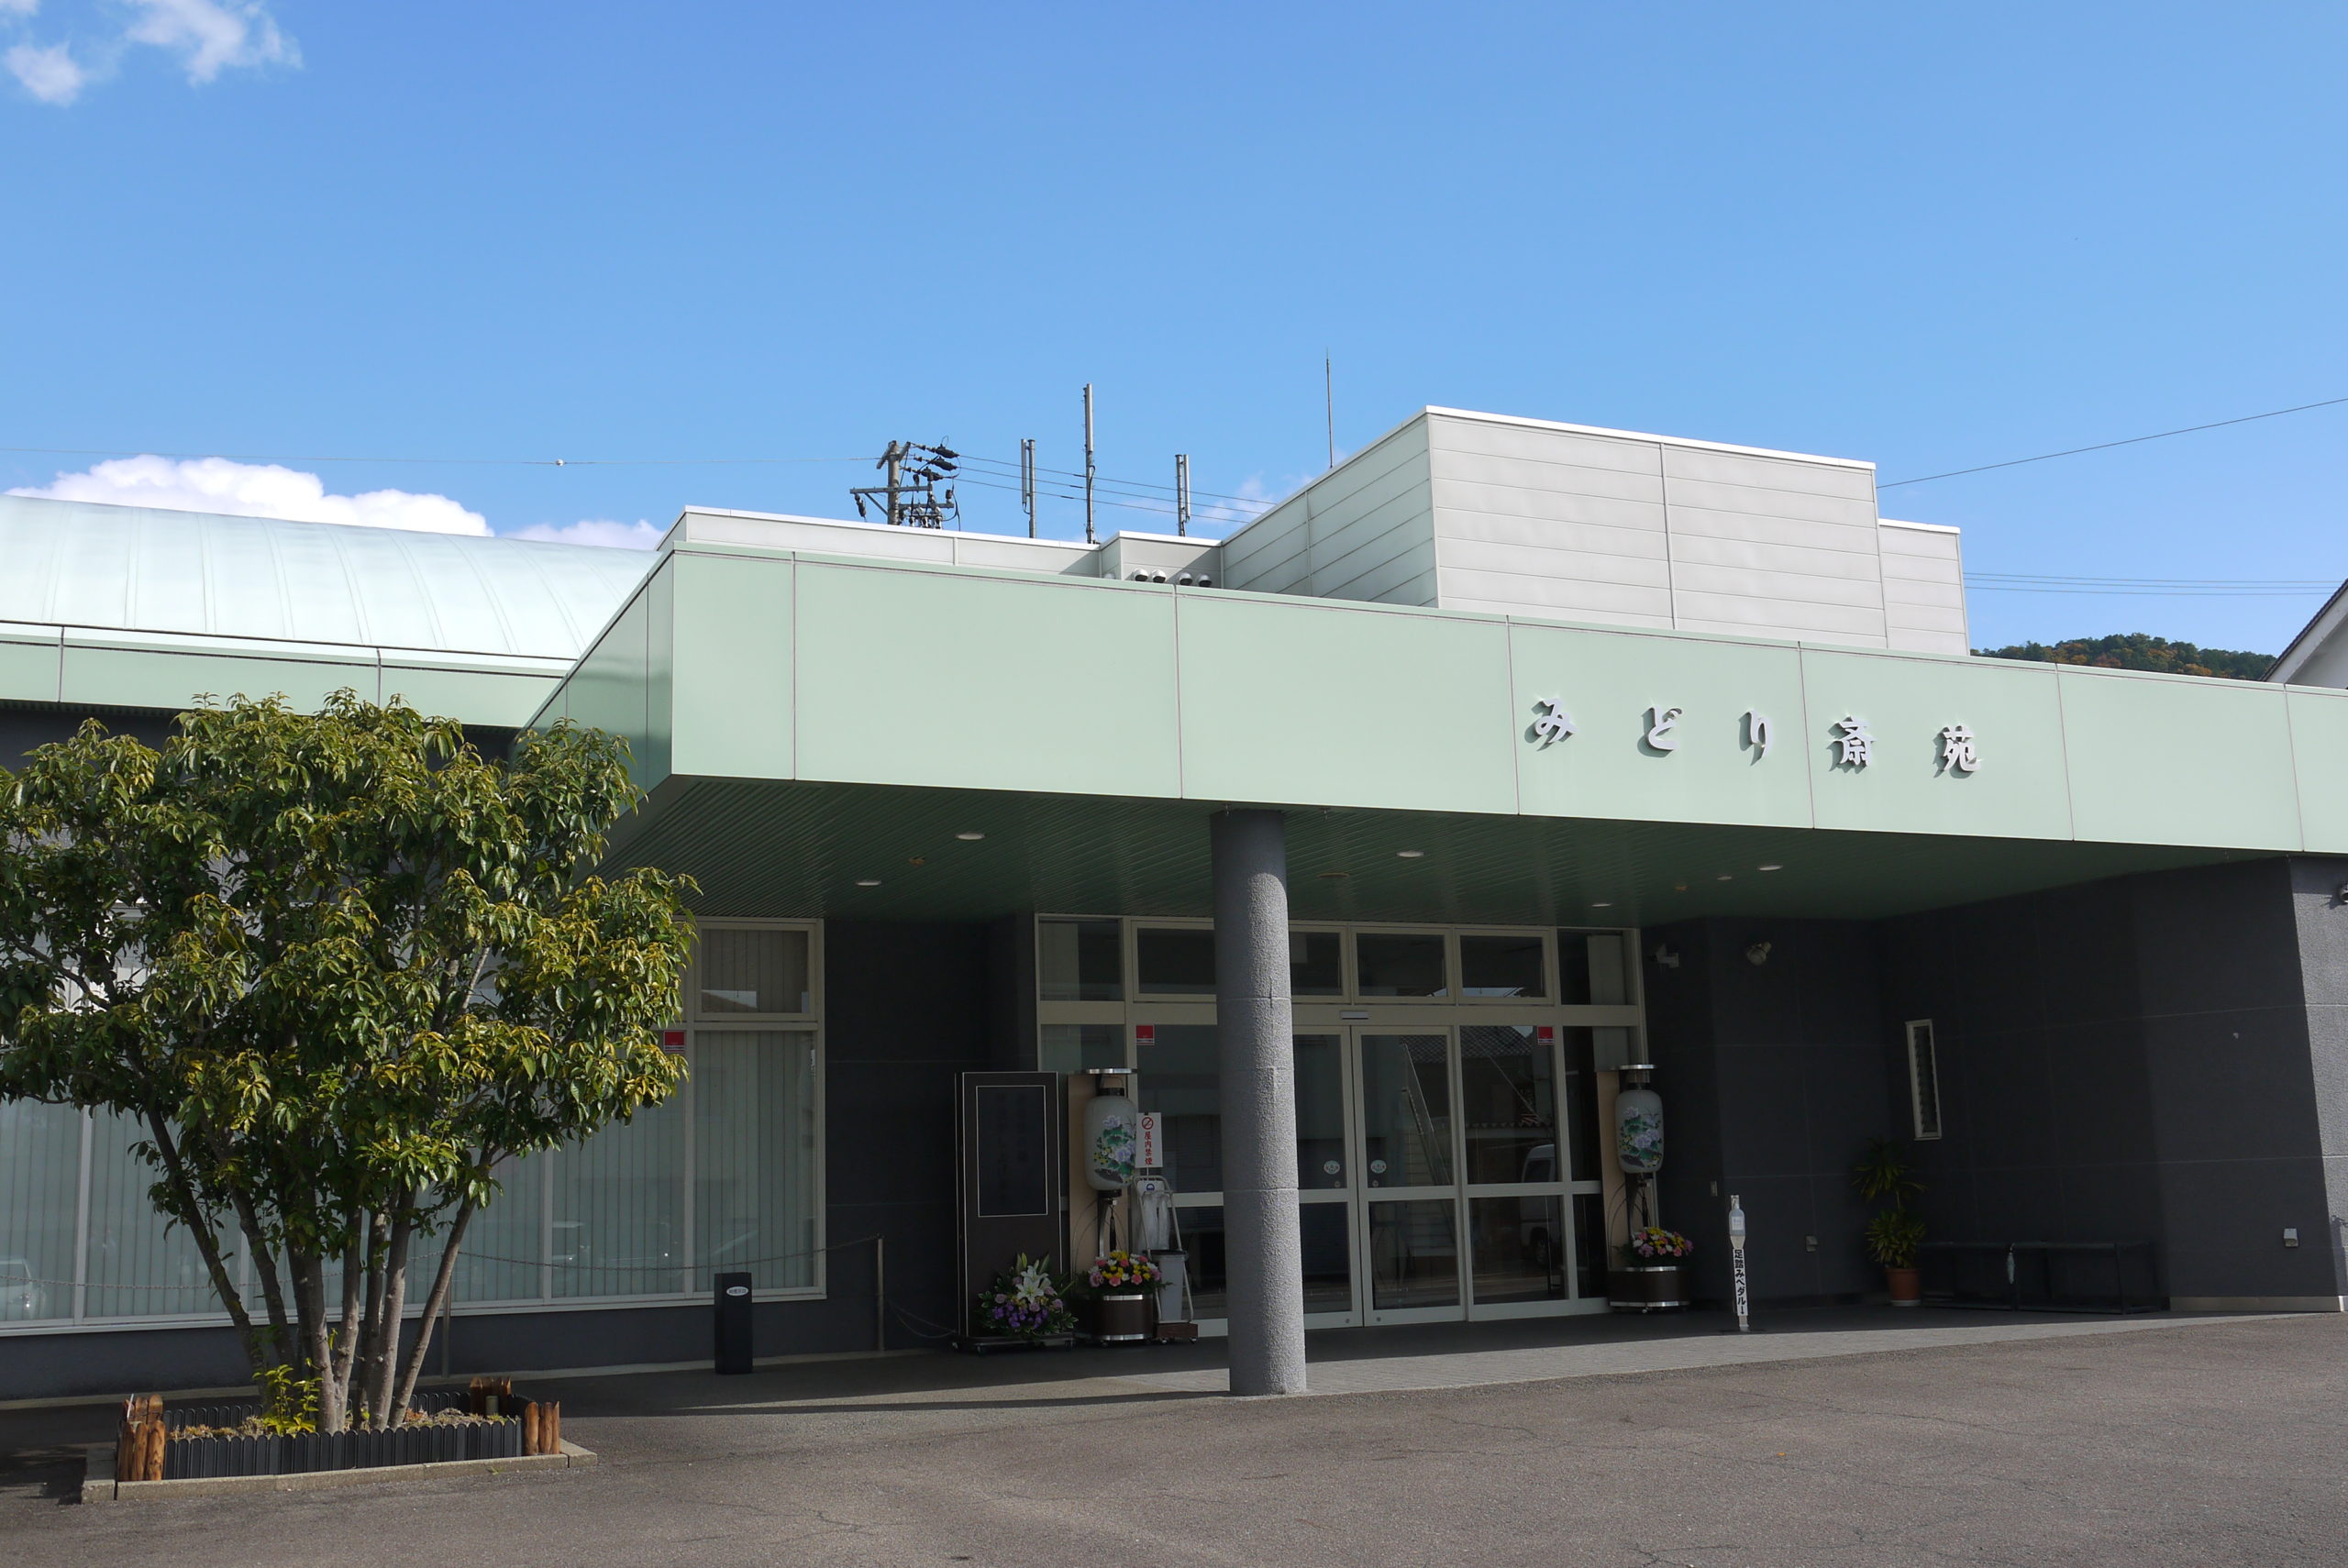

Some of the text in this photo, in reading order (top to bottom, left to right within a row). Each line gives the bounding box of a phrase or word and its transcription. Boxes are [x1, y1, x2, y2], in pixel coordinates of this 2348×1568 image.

[1535, 697, 1981, 772] みどり斎苑
[1144, 1131, 1153, 1165] 屋内禁煙
